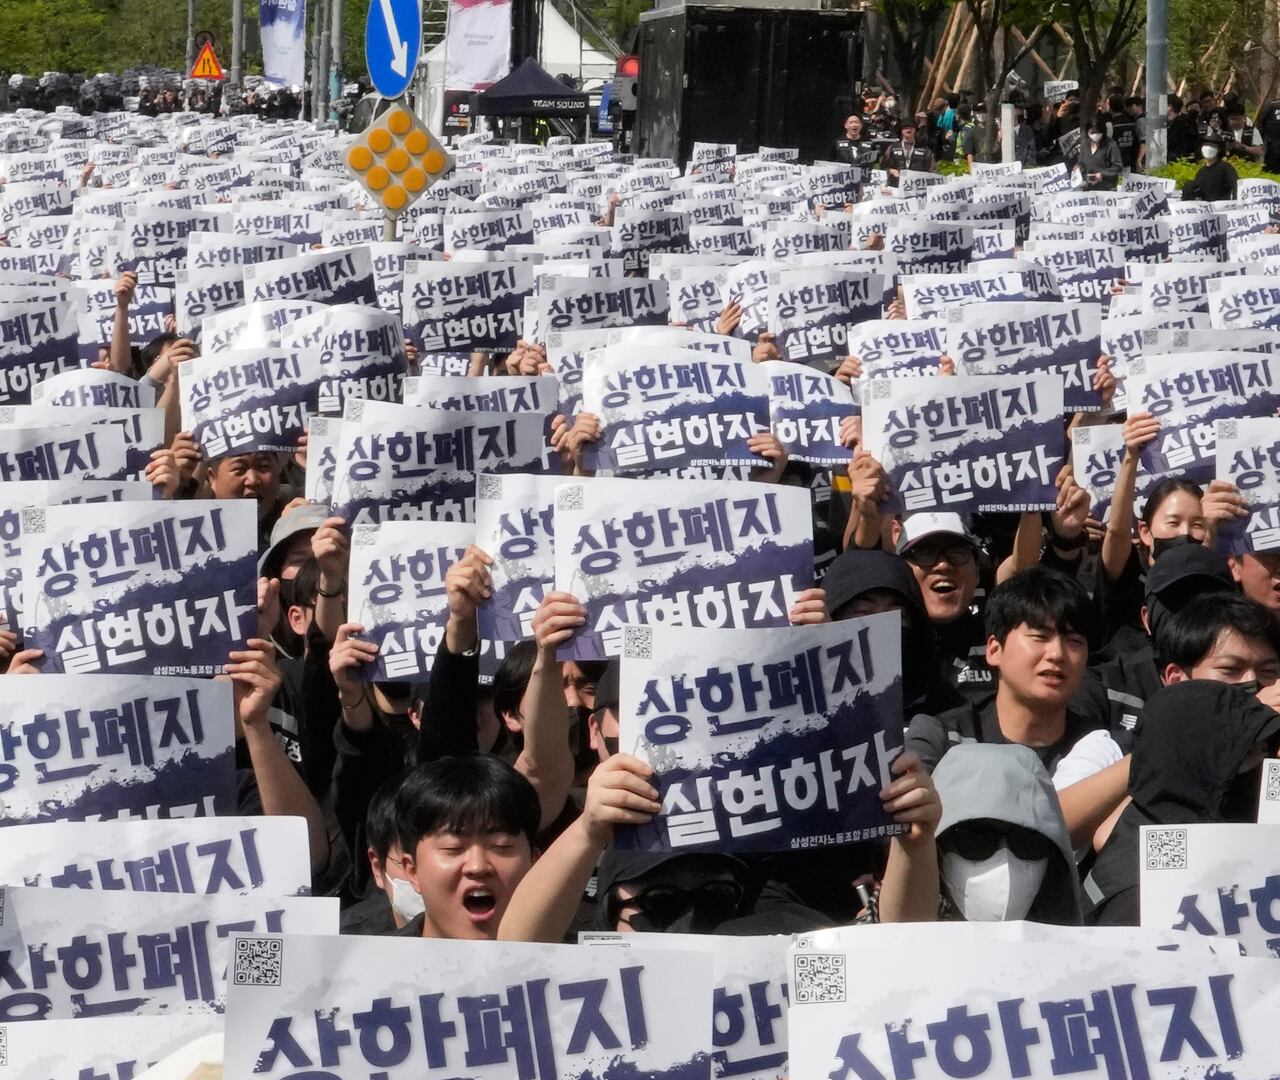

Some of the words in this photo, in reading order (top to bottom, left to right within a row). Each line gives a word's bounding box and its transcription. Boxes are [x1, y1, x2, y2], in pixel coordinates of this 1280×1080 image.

[532, 100, 555, 109] TEAM
[129, 217, 220, 250] 상한폐지
[450, 212, 523, 248] 상한폐지
[774, 233, 844, 258] 상한폐지
[1092, 223, 1160, 248] 상한폐지
[252, 254, 355, 303] 상한폐지
[413, 272, 515, 309] 상한폐지
[775, 275, 870, 317] 상한폐지
[914, 275, 1008, 303] 상한폐지
[420, 310, 525, 350] 실현하자
[957, 311, 1082, 360] 상한폐지
[190, 352, 303, 410] 상한폐지
[602, 360, 743, 410] 상한폐지
[1142, 355, 1273, 415] 상한폐지
[200, 403, 312, 455] 실현하자
[608, 413, 760, 463] 실현하자
[886, 382, 1039, 449] 상한폐지
[345, 419, 517, 482] 상한폐지
[898, 446, 1062, 511] 실현하자
[37, 507, 227, 597] 상한폐지
[572, 495, 780, 574] 상한폐지
[54, 588, 257, 676] 실현하자
[153, 665, 213, 676] 삼성전자노동조합
[636, 629, 874, 745] 상한폐지
[659, 731, 902, 849] 실현하자
[790, 832, 860, 849] 삼성전자노동조합
